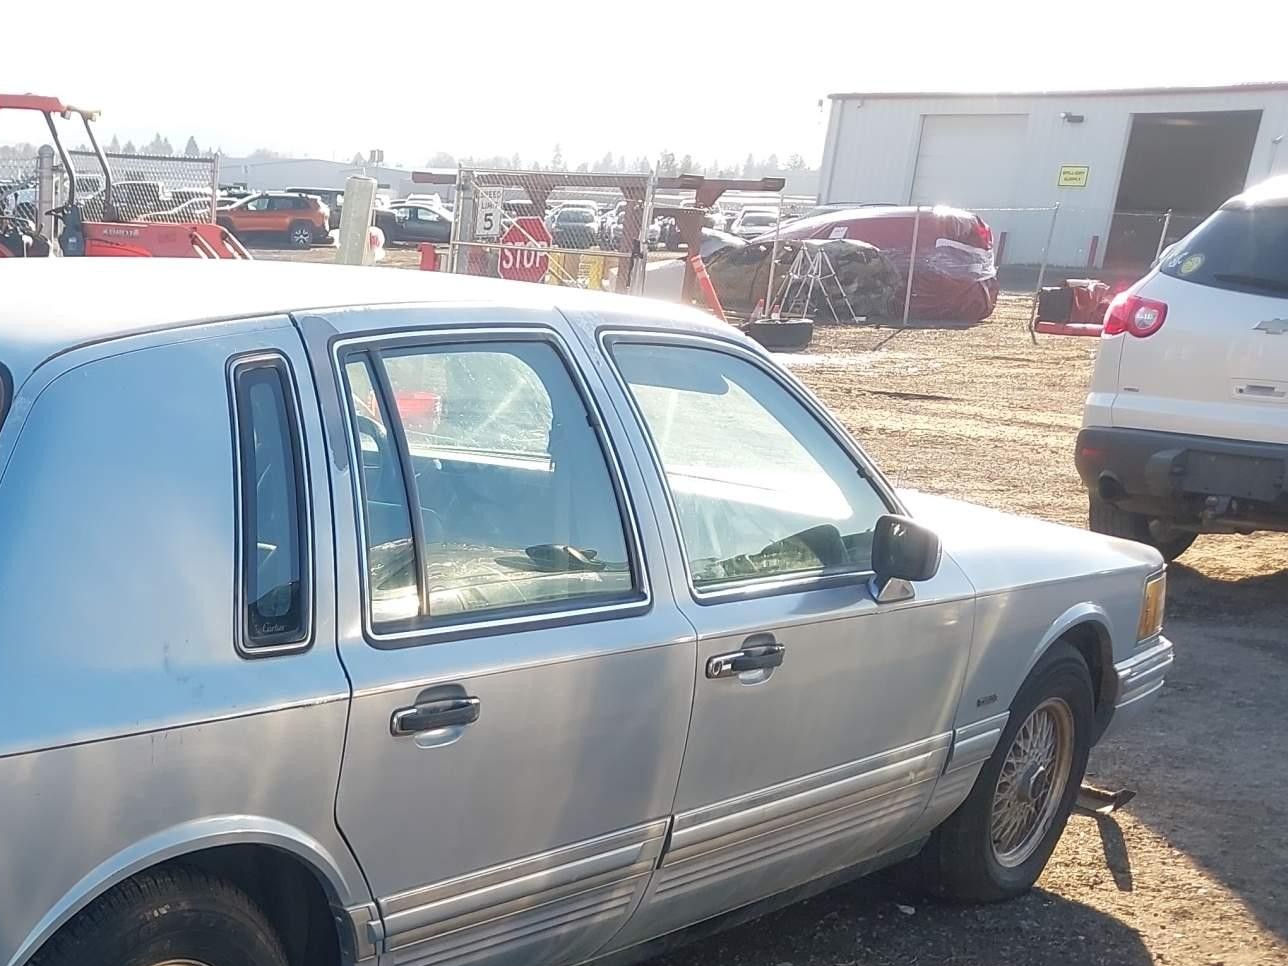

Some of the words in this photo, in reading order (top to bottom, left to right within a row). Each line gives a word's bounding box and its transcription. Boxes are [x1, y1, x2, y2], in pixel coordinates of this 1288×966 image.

[480, 190, 501, 199] SPEED
[483, 212, 494, 231] 5
[502, 241, 548, 269] STOP
